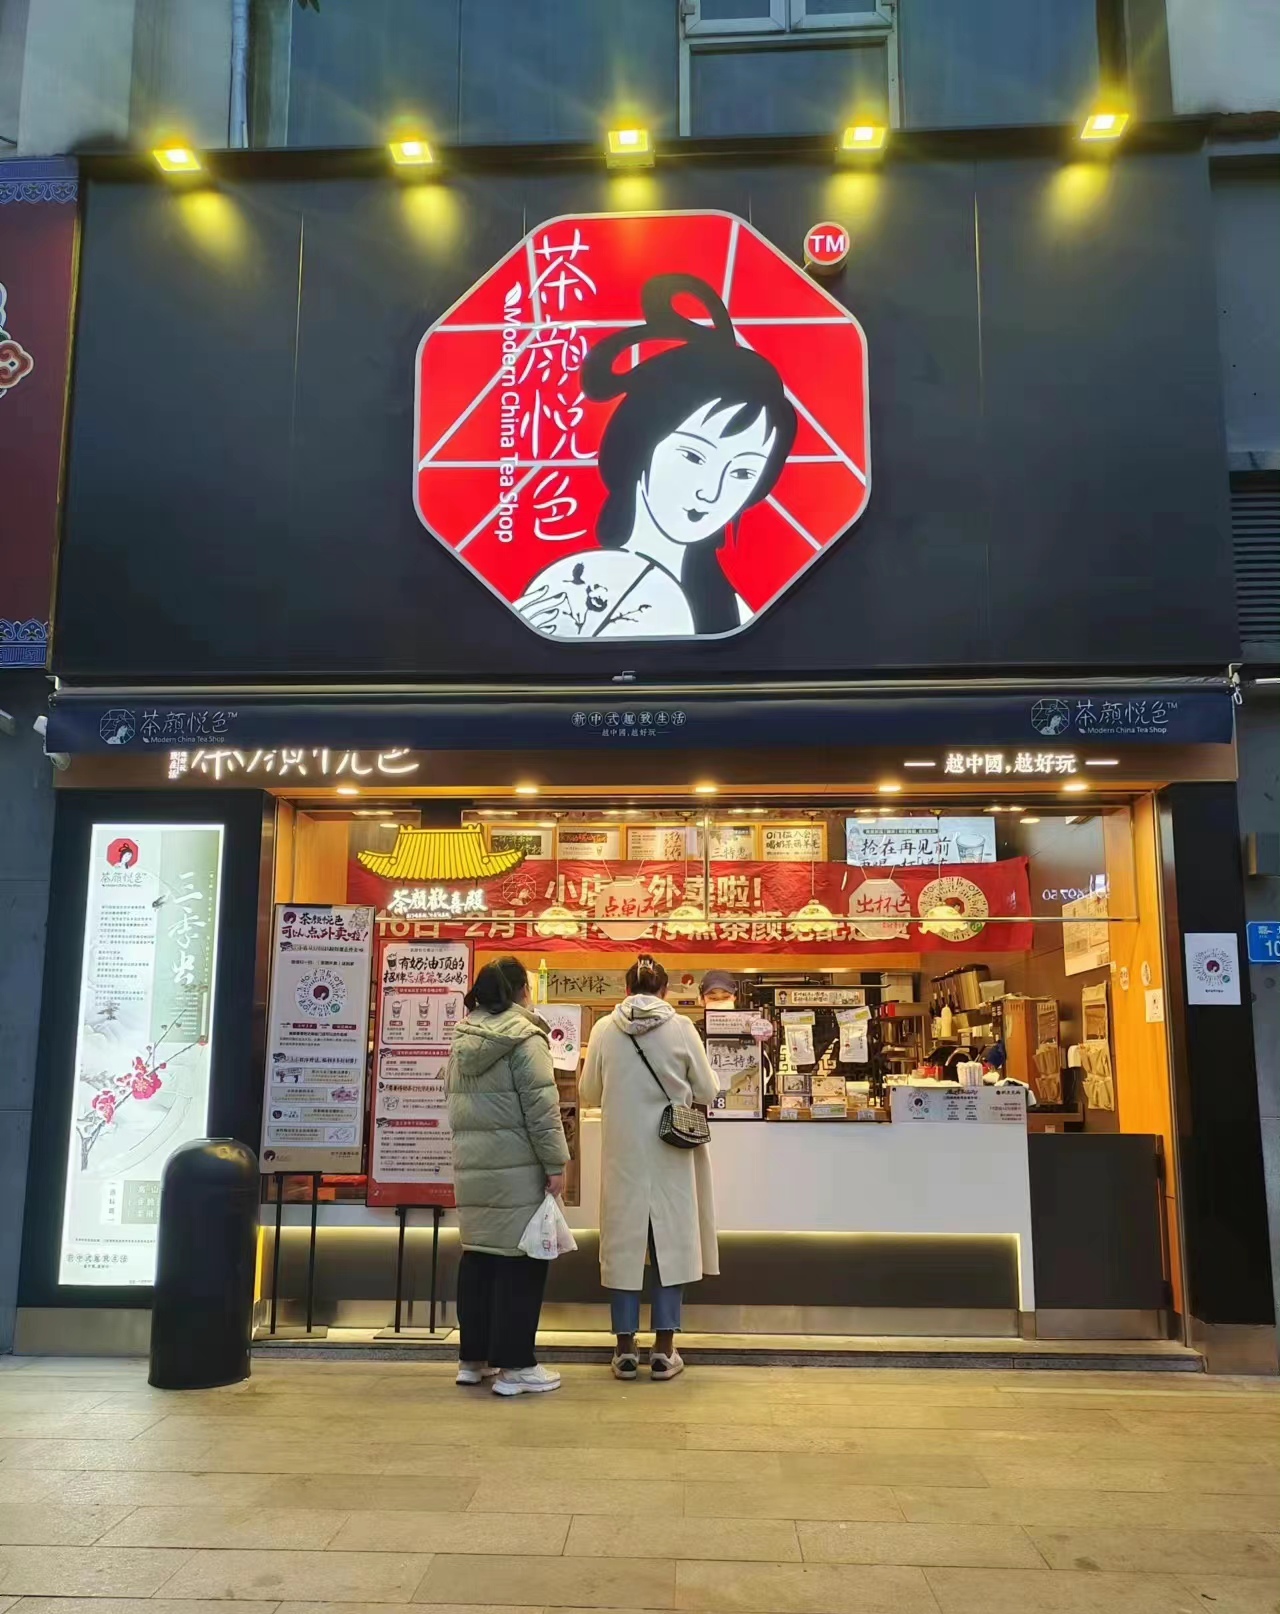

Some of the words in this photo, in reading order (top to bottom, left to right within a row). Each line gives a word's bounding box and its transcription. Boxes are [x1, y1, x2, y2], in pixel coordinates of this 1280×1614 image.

[809, 234, 845, 253] TM
[500, 306, 520, 387] Modern
[499, 391, 519, 448] China
[499, 452, 518, 487] Tea
[493, 491, 517, 543] Shop
[208, 735, 225, 745] Shop
[1149, 726, 1167, 735] Shop
[861, 837, 952, 857] 抢在再见前
